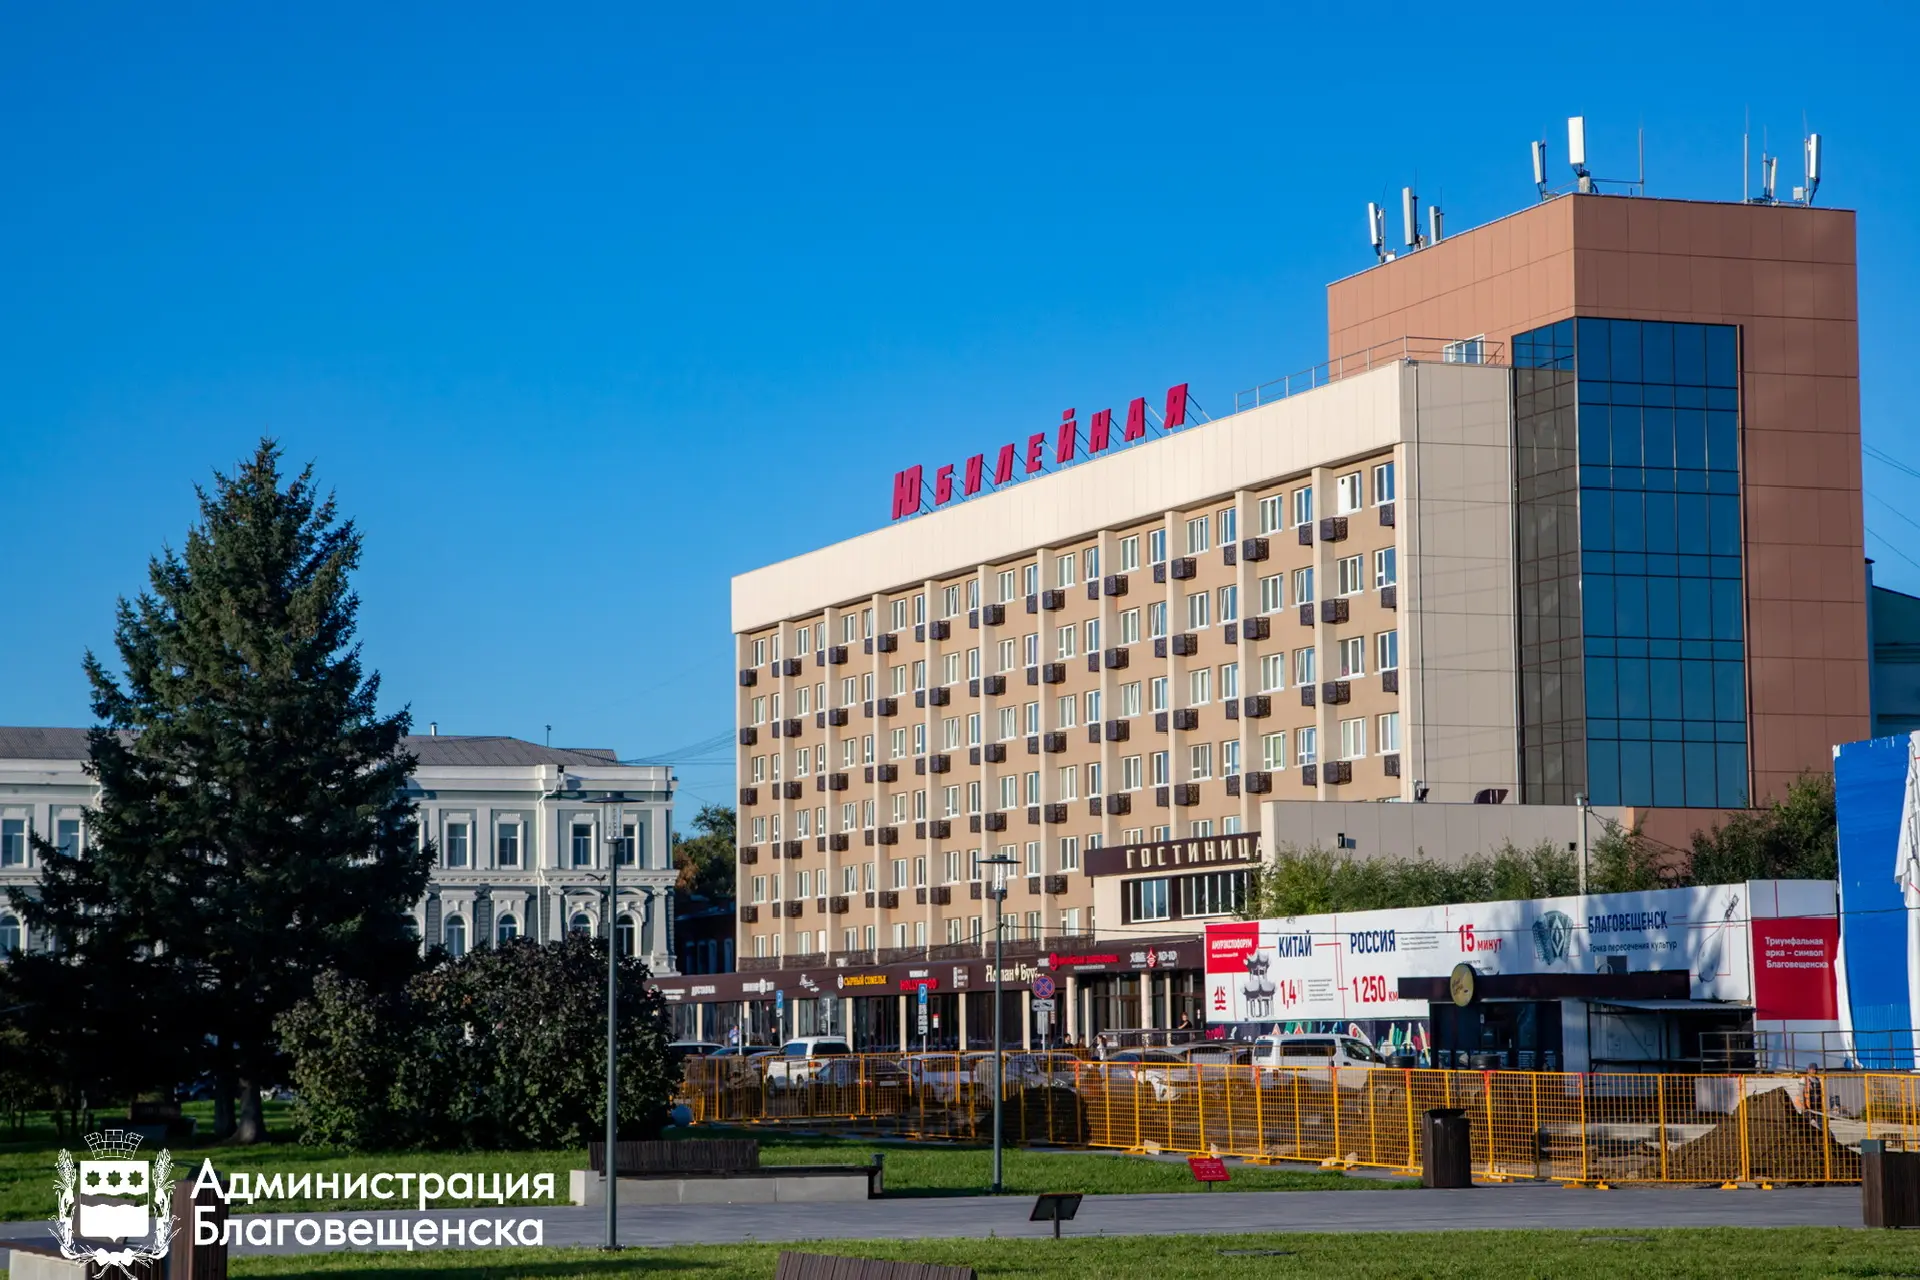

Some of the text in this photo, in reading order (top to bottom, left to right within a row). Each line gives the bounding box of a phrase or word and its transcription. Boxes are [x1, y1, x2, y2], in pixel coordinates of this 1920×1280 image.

[892, 383, 1188, 520] ЮБИЛЕЙНАЯ
[1126, 836, 1261, 869] ГОСТИНИЦА
[1588, 911, 1668, 934] БЛАГОВЕЩЕНСК
[1278, 930, 1312, 958] КИТАЙ
[1350, 929, 1396, 954] РОССИЯ
[1459, 924, 1474, 952] 15
[1477, 938, 1502, 953] минут
[1589, 940, 1678, 954] Точка пересечения культур
[1765, 936, 1824, 947] Триумфальная
[1765, 949, 1785, 958] арка
[1794, 949, 1824, 957] символ
[1766, 959, 1829, 969] Благовещенска
